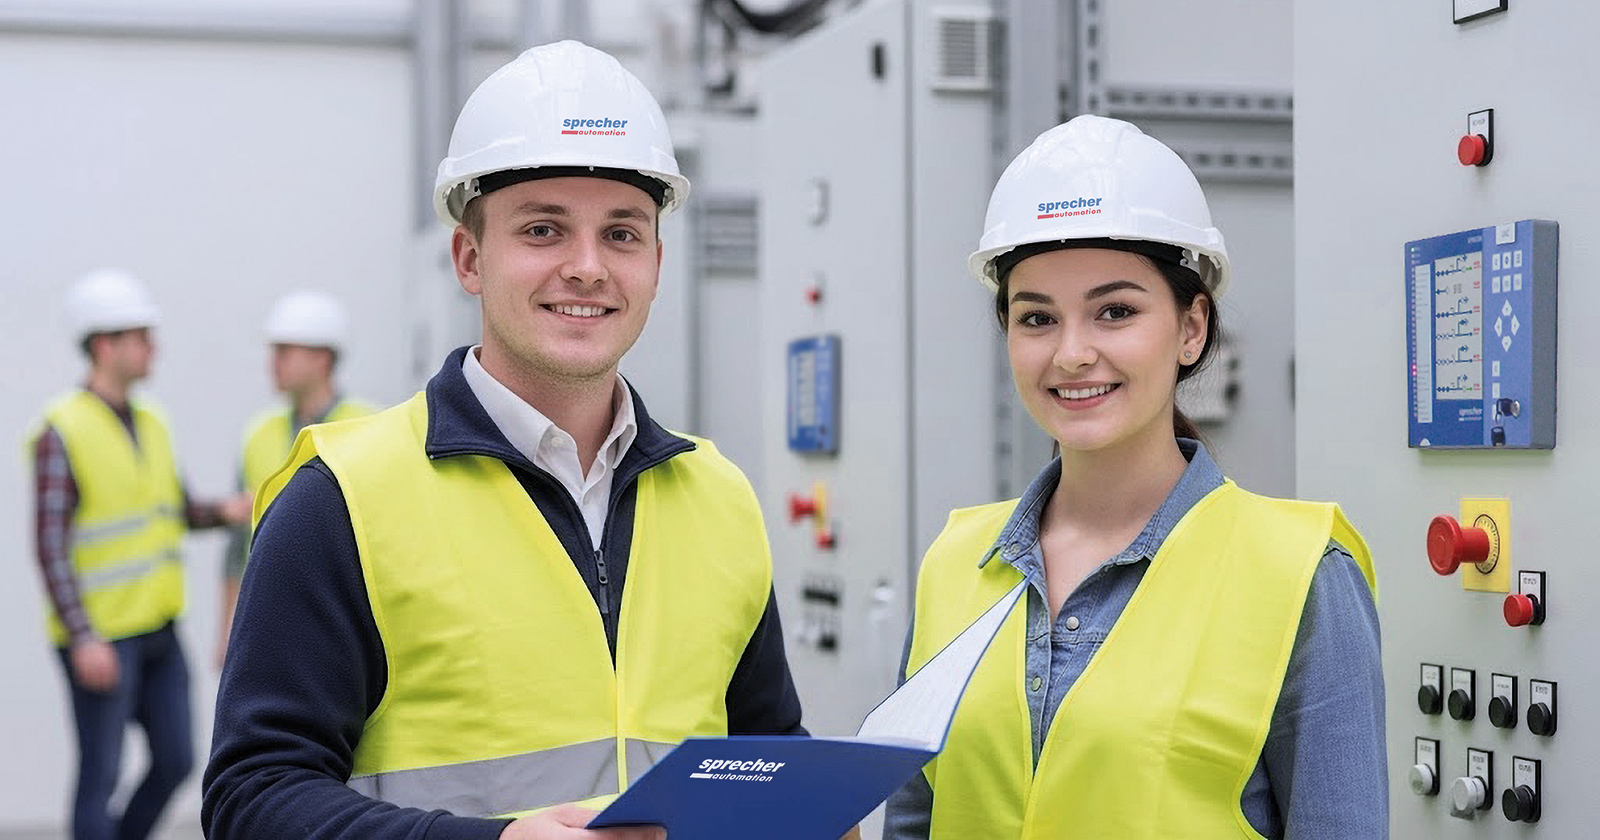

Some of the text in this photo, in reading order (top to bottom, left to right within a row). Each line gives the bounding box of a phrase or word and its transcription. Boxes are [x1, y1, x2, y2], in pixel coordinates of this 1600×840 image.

[562, 117, 628, 130] sprecher
[1037, 197, 1102, 213] sprecher
[1054, 208, 1102, 218] automation
[698, 758, 786, 773] sprecher
[712, 773, 773, 782] automation
